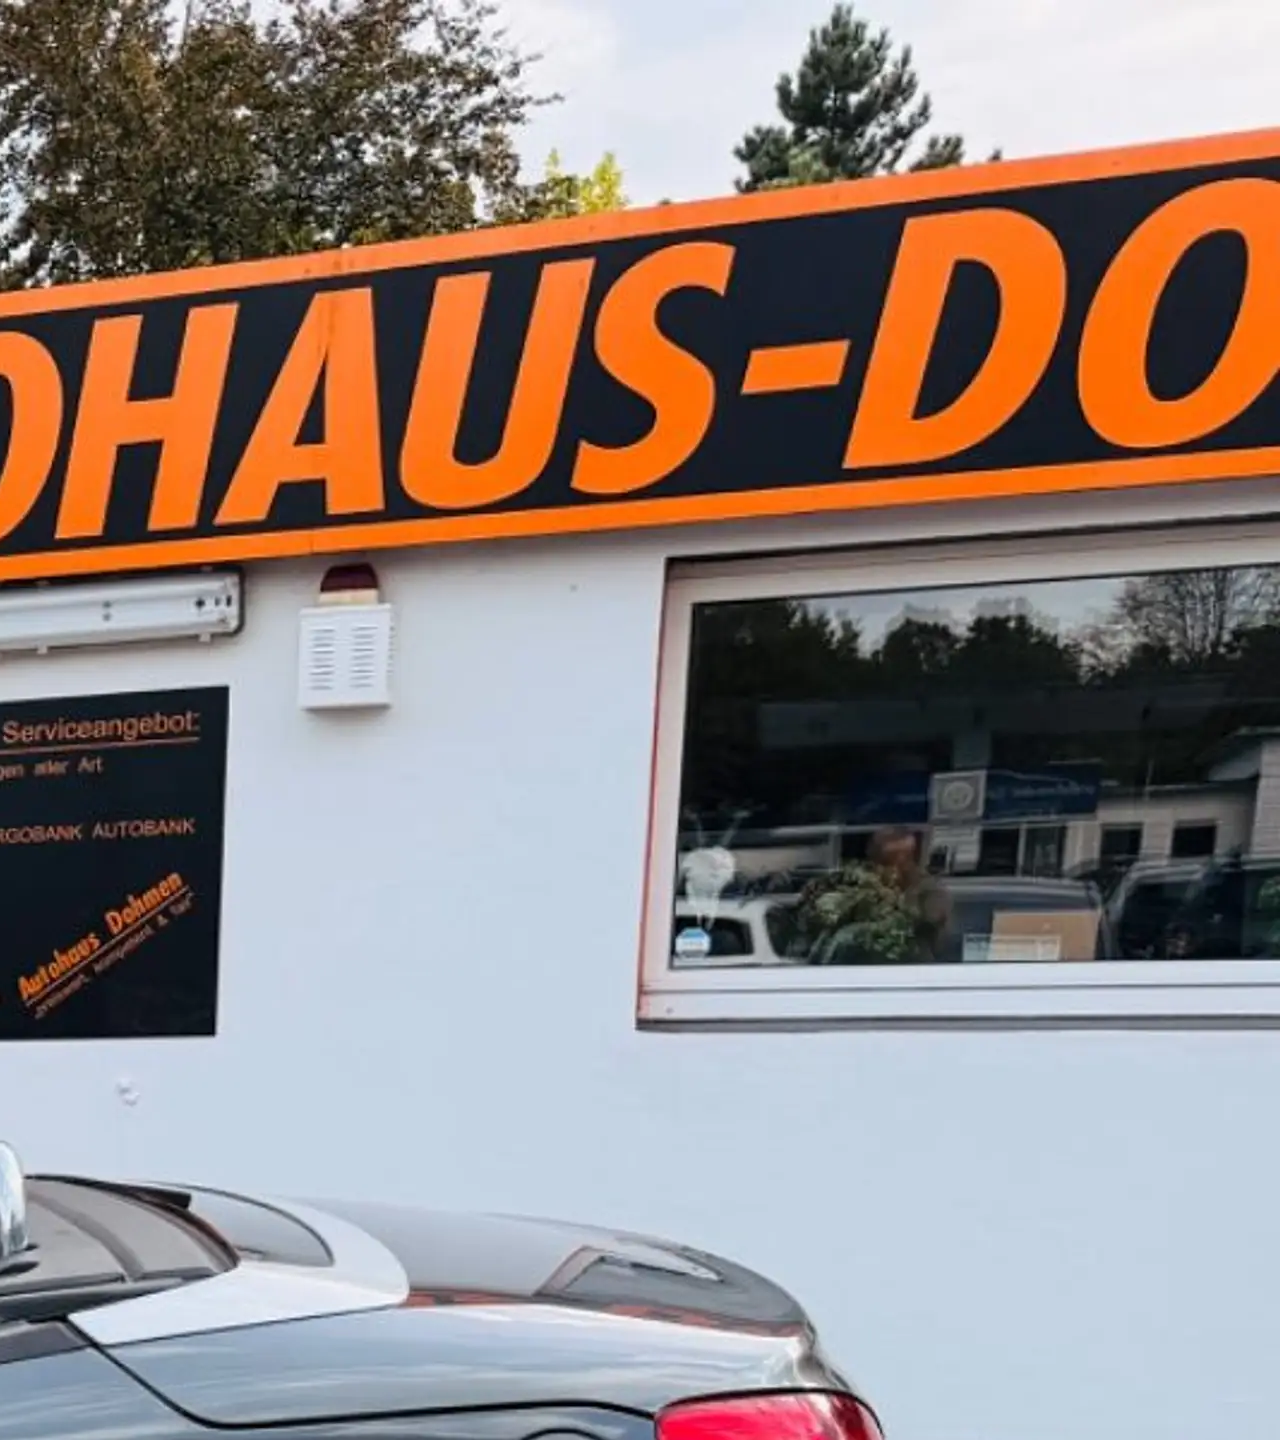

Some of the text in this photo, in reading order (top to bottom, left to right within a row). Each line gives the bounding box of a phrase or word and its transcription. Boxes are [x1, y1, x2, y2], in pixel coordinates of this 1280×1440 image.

[2, 710, 201, 743] Serviceangebot:
[77, 756, 104, 774] Art
[92, 817, 196, 838] AUTOBANK
[18, 932, 101, 1001] Autohaus
[104, 872, 183, 936] Dohmen
